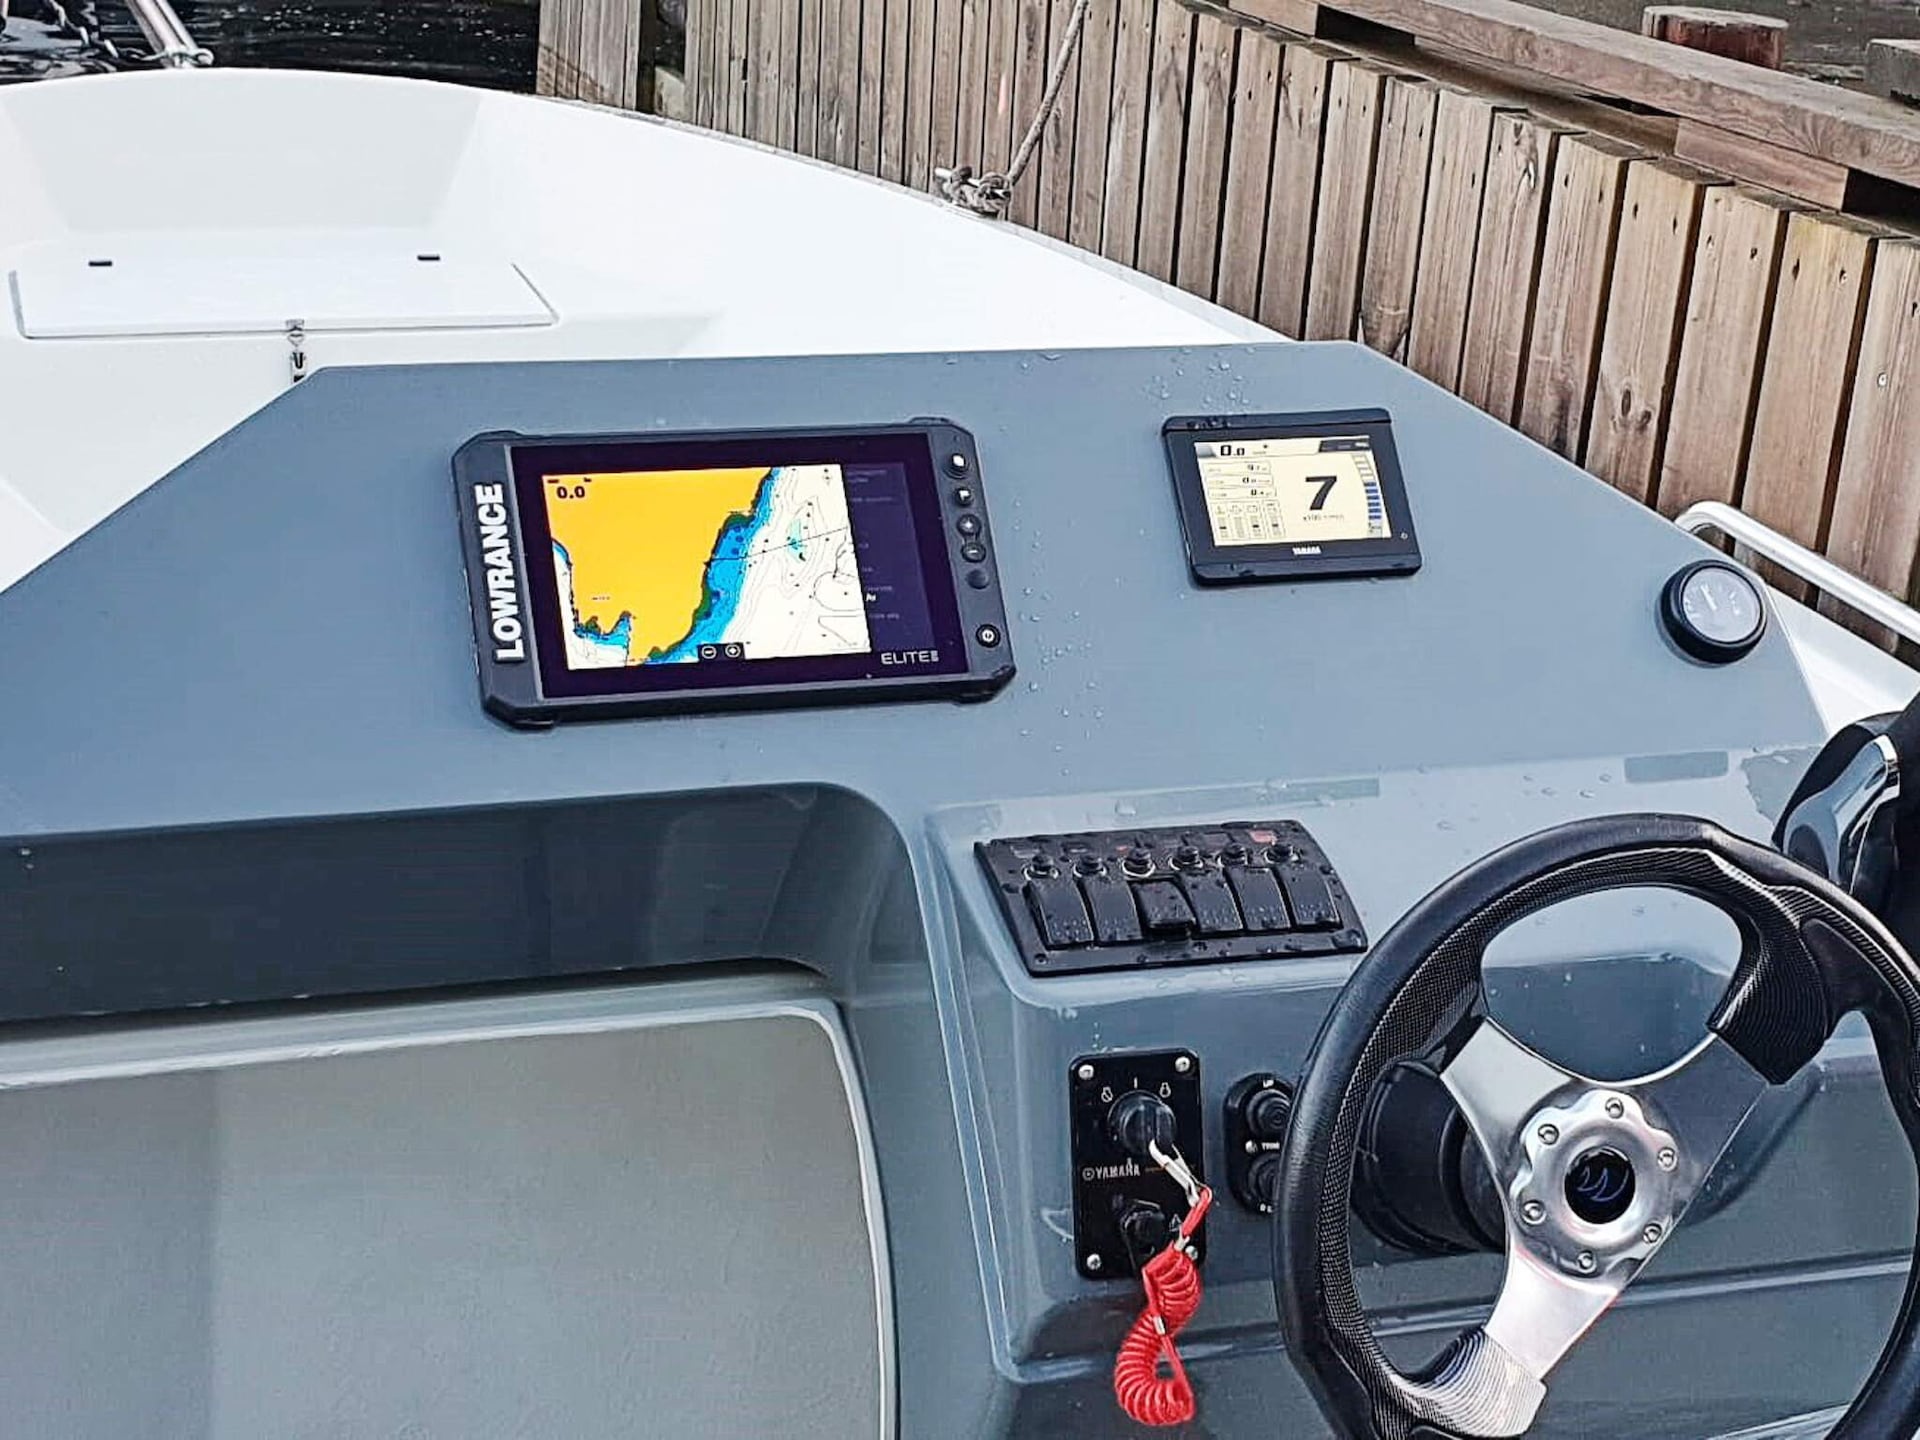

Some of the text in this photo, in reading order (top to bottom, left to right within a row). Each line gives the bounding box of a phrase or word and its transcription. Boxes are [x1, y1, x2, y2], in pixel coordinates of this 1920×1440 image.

[556, 486, 586, 499] 0.0
[1305, 476, 1337, 510] 7
[474, 483, 525, 661] LOWRANCE
[880, 651, 931, 665] ELITE
[1095, 1162, 1140, 1180] YAMAHA
